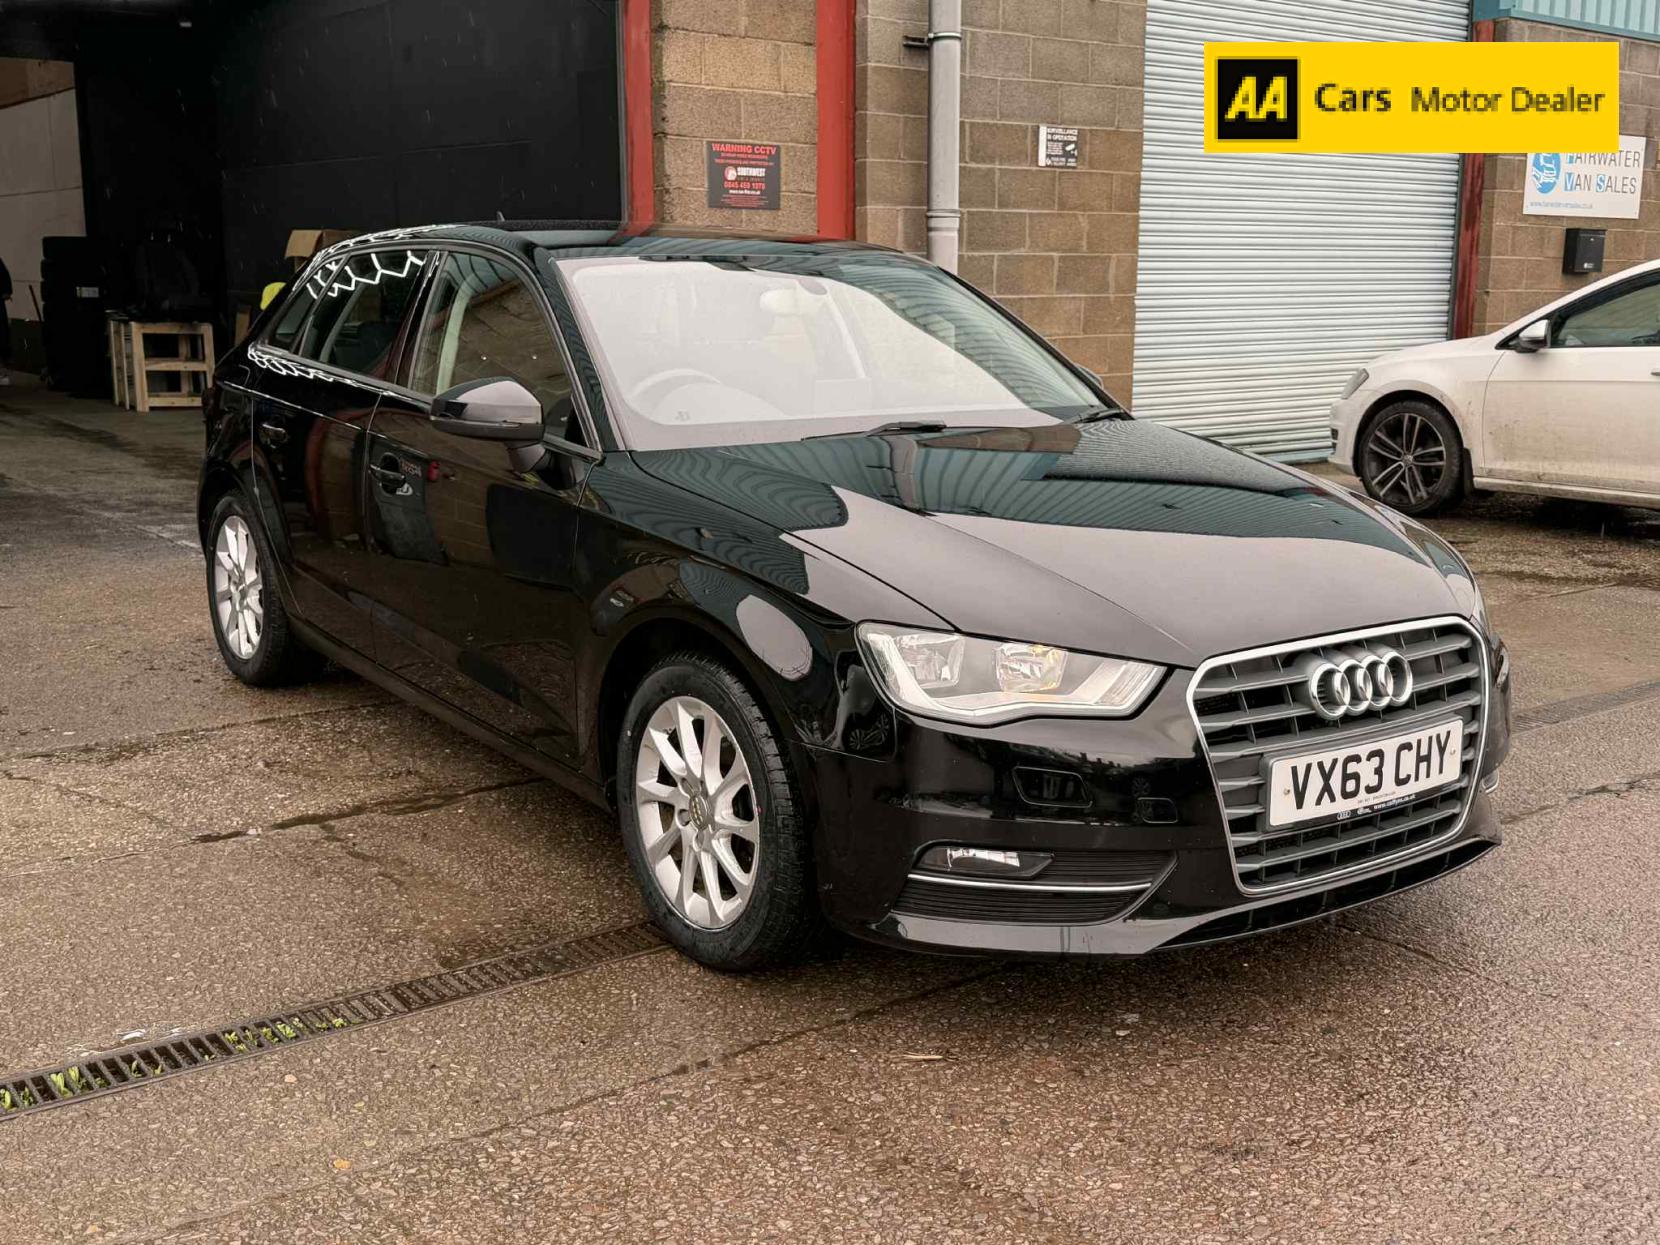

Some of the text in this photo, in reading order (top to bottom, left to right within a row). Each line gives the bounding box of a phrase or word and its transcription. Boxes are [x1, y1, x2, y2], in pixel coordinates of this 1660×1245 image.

[712, 143, 752, 153] WARNING
[754, 146, 776, 155] CCTV
[1564, 172, 1637, 194] VAN SALES
[1290, 730, 1451, 810] VX63 CHY
